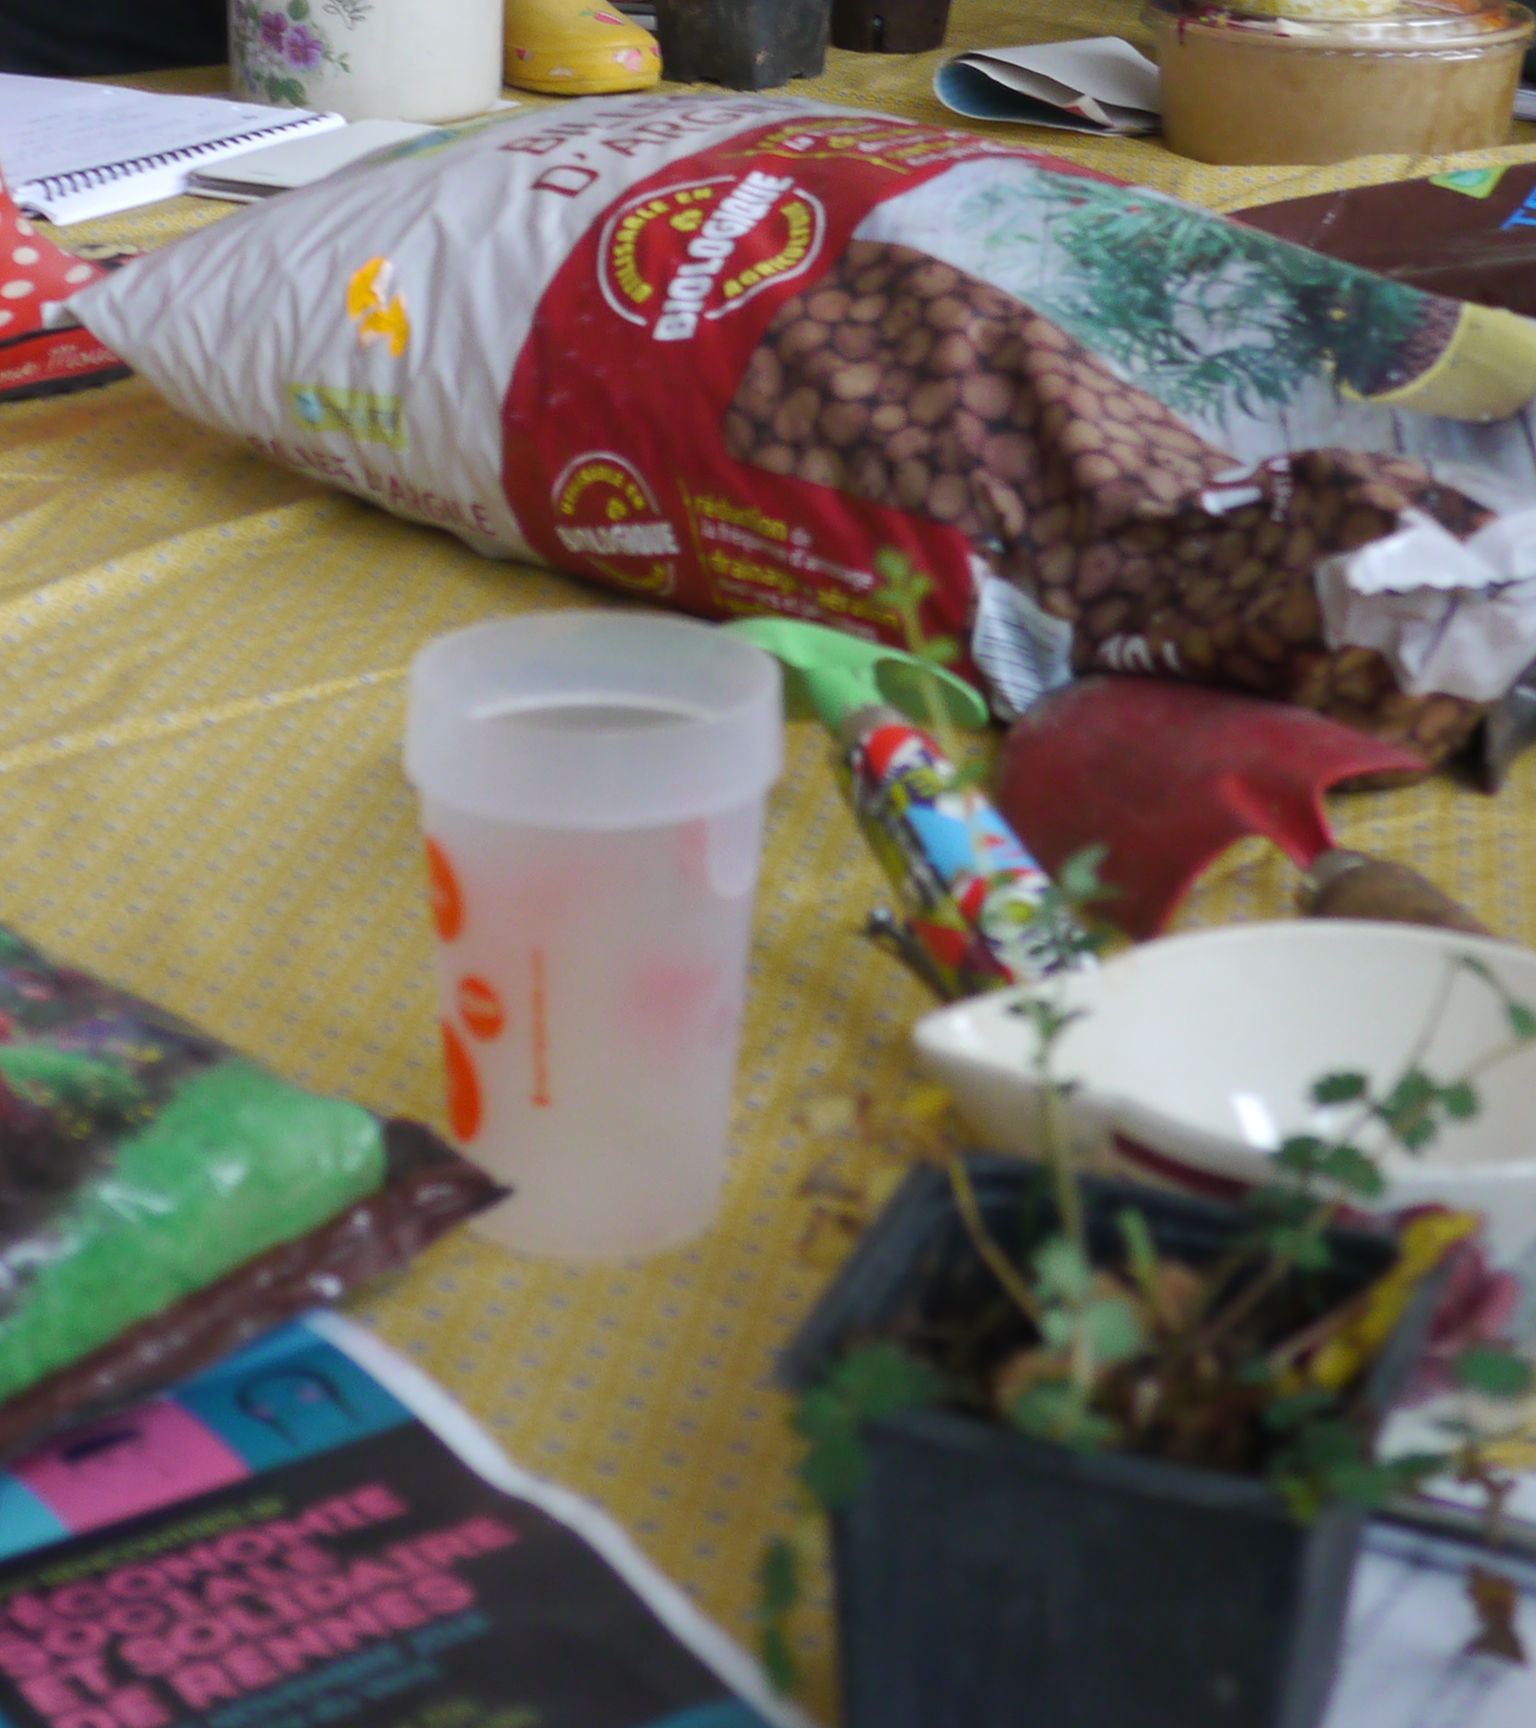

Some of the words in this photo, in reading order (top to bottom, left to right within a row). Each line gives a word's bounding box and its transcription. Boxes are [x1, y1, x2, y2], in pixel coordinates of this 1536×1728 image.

[652, 170, 795, 342] BIOLOGIQUE
[116, 1514, 521, 1674] SOLIDAIRE
[168, 1573, 478, 1711] RENNES
